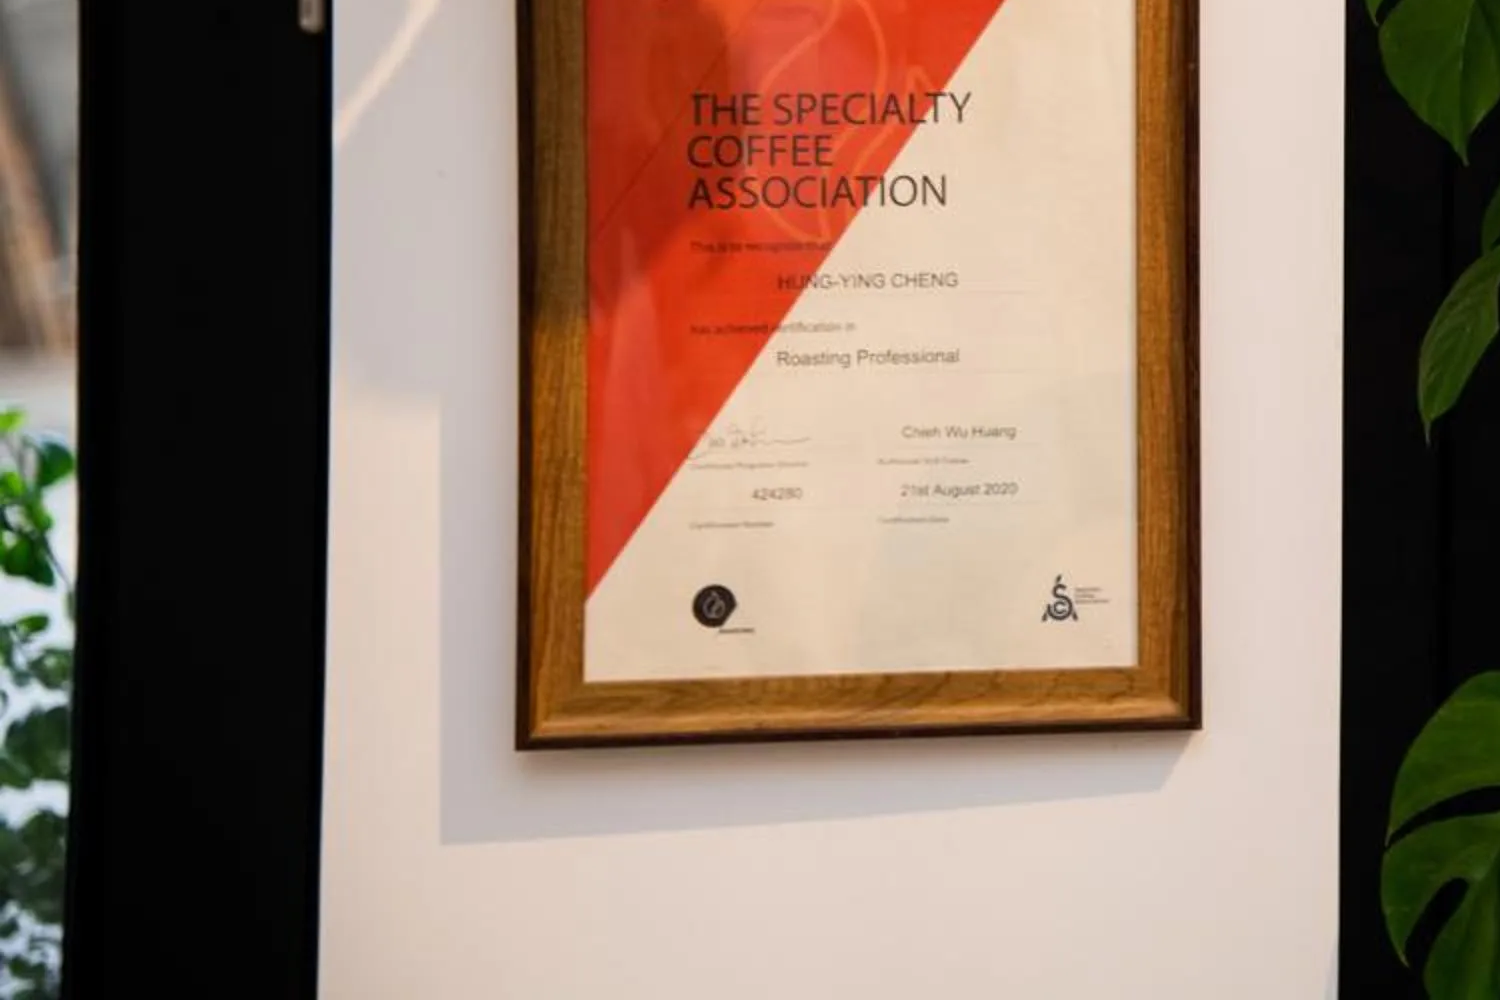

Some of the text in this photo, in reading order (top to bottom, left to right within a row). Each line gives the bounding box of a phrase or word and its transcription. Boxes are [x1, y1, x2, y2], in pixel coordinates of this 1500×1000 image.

[690, 91, 972, 126] THE SPECIALTY
[687, 134, 834, 168] COFFEE
[688, 174, 947, 210] ASSOCIATION
[776, 272, 960, 290] HUNG-YING CHENG
[776, 348, 961, 369] Roasting Professional
[971, 426, 1017, 440] Huang
[933, 483, 981, 499] August
